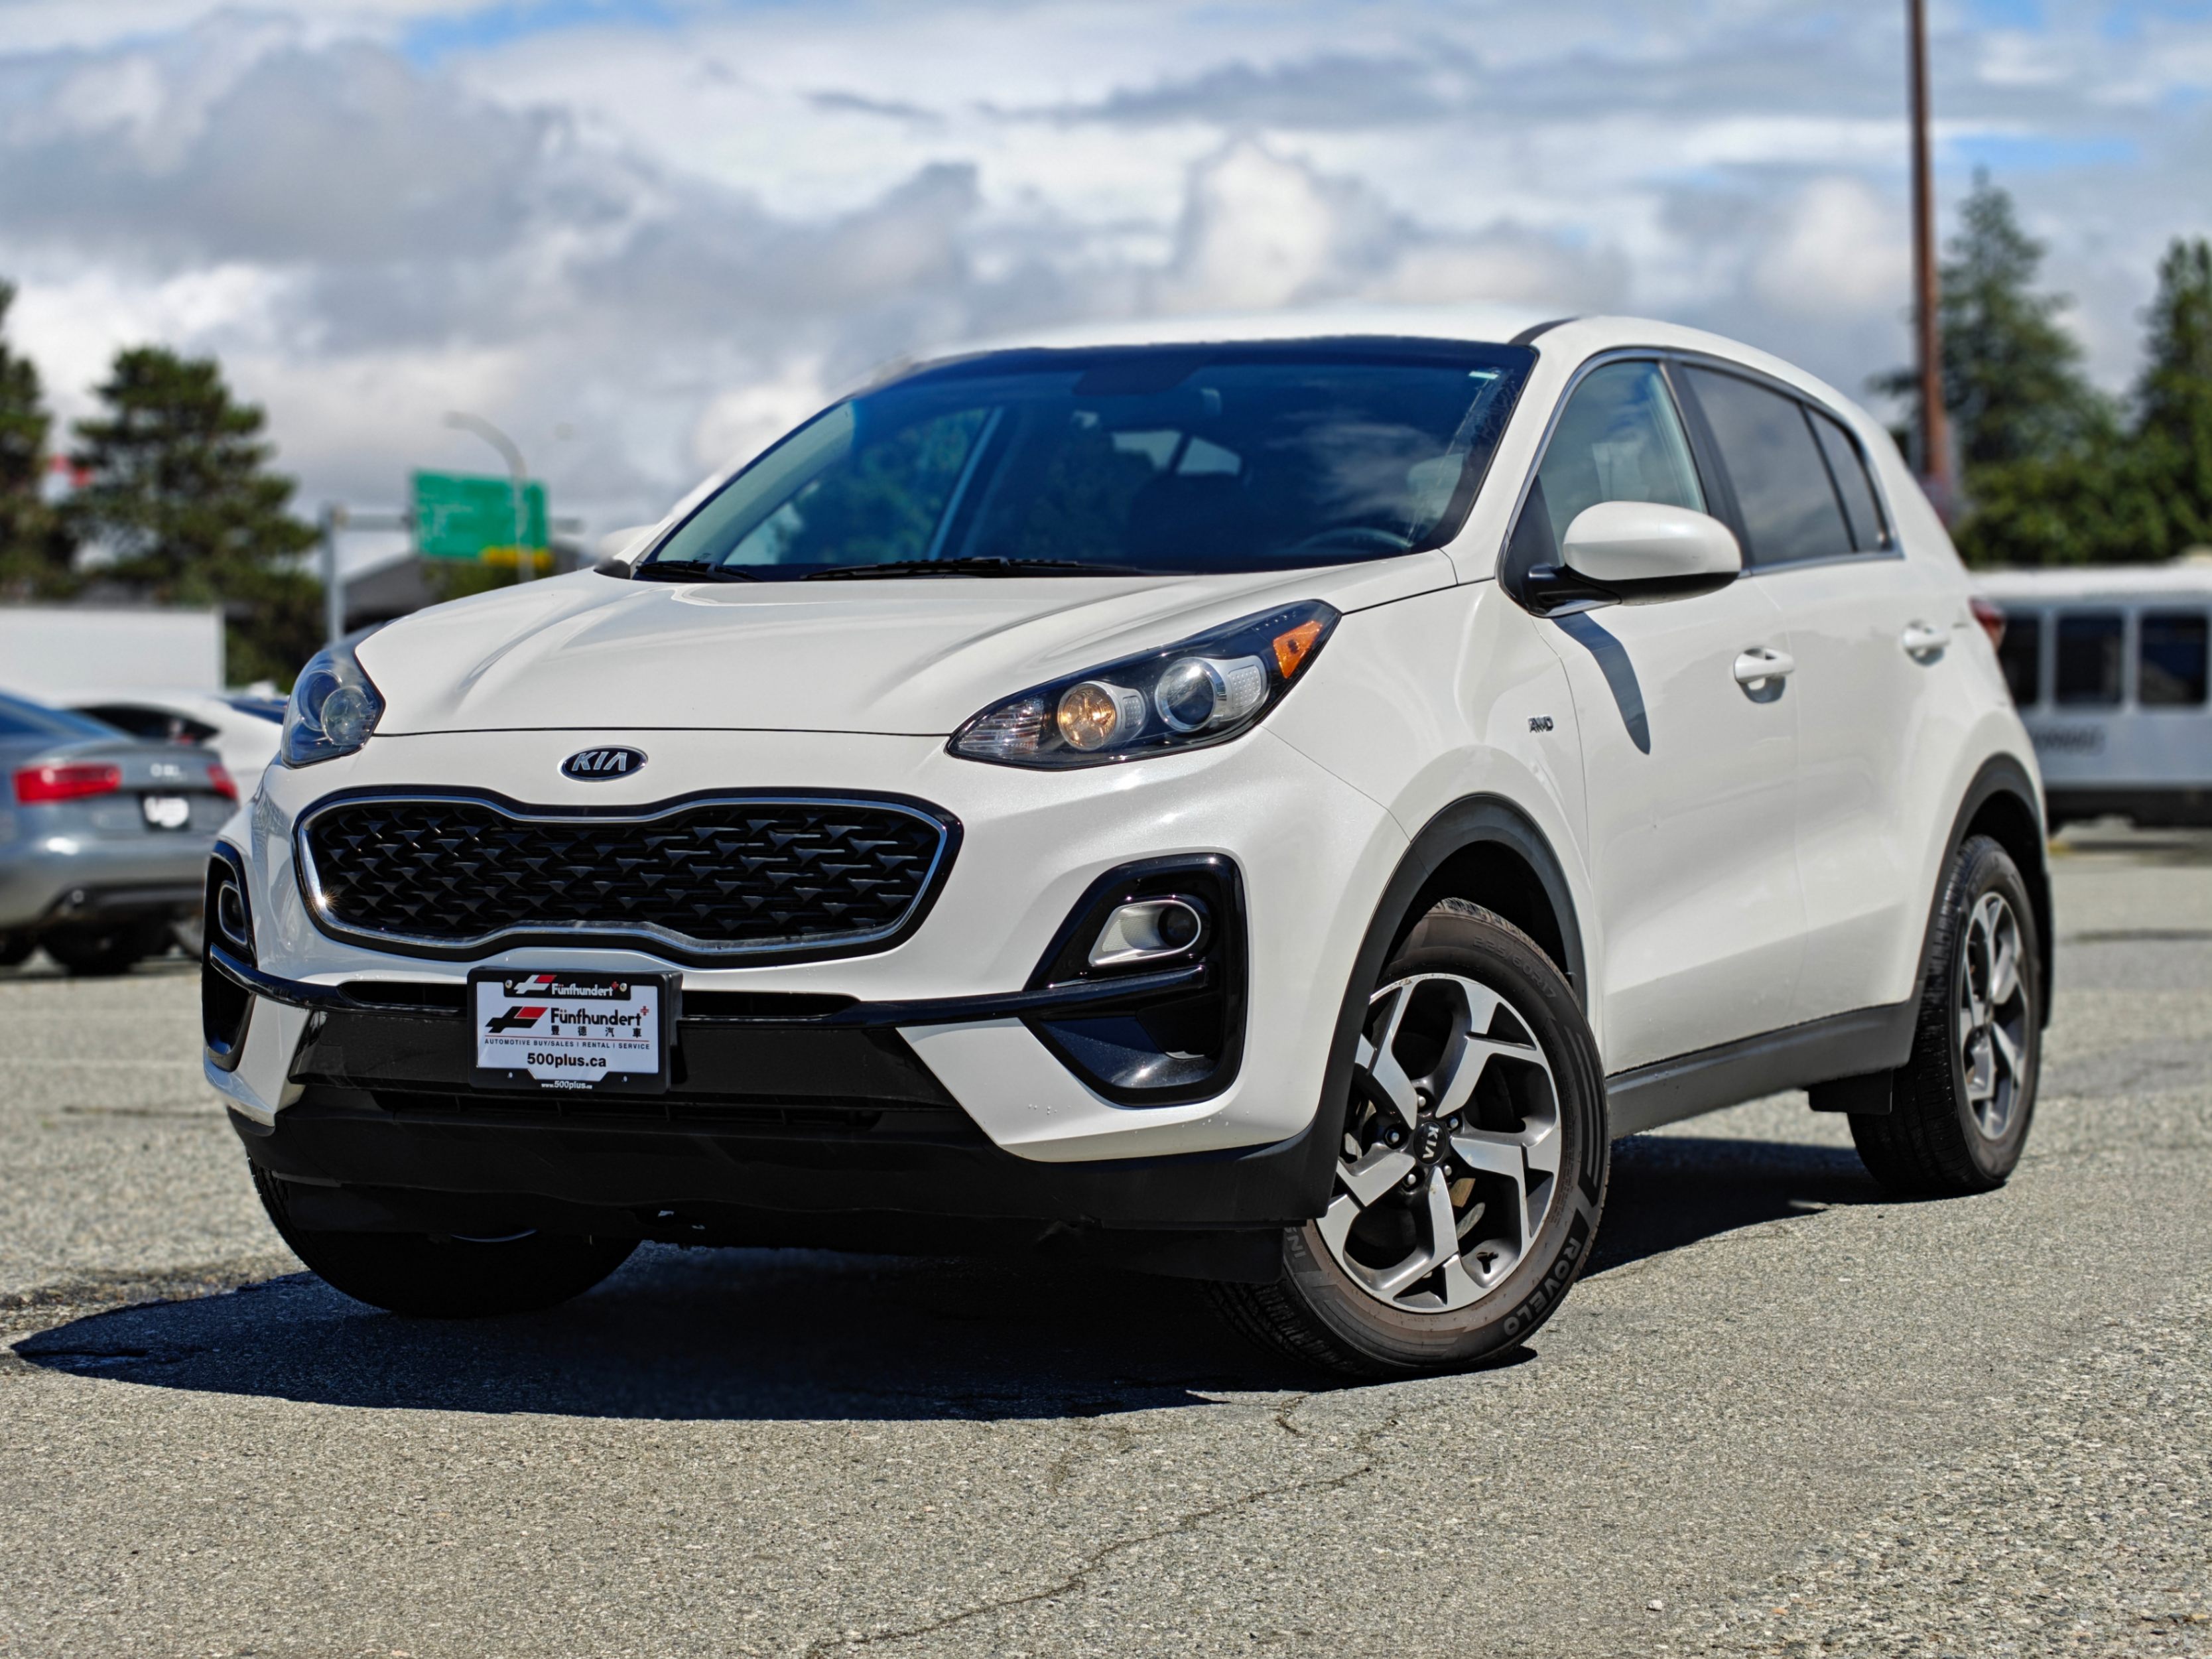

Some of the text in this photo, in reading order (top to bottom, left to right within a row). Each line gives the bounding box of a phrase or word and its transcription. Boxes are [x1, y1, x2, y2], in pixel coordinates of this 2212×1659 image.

[571, 751, 627, 771] KIA
[527, 1053, 607, 1068] 500plus.ca
[1422, 1126, 1439, 1158] KIA
[1504, 1237, 1582, 1336] ROVELO
